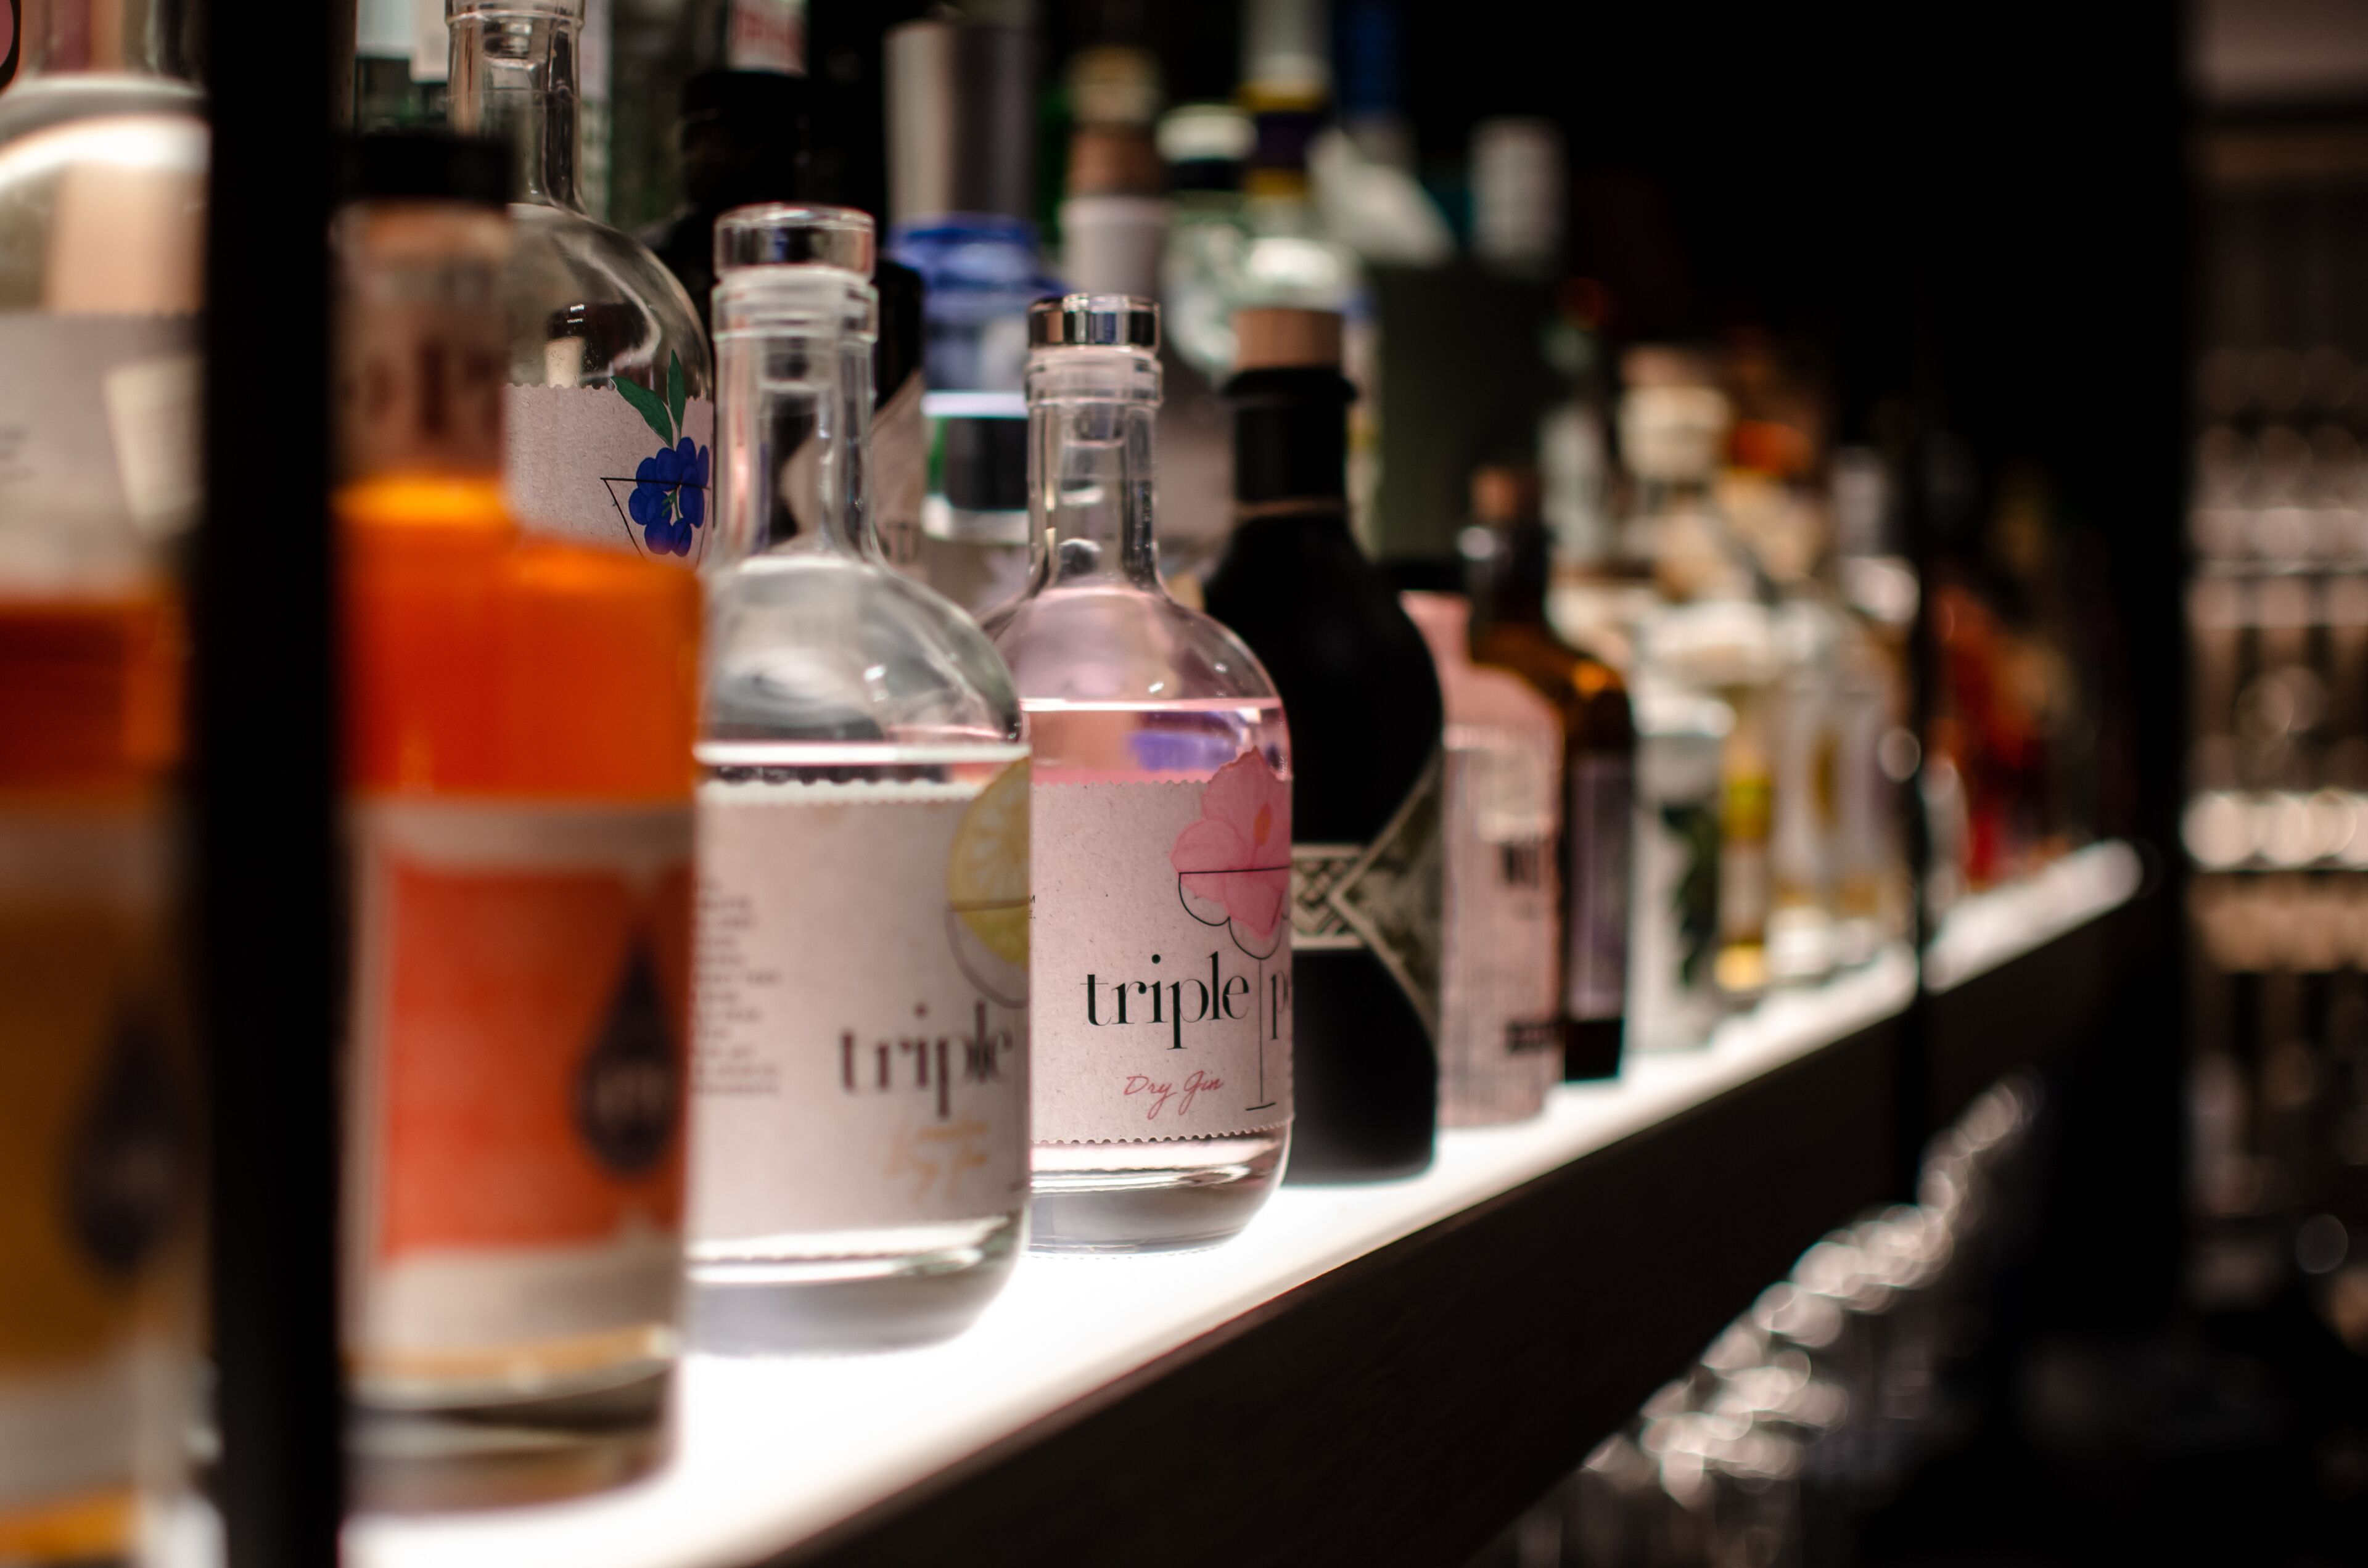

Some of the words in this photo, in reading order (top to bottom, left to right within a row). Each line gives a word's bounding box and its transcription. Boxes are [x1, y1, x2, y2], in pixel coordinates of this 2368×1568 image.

[1080, 951, 1249, 1050] triple
[1124, 1075, 1177, 1120] Dry
[1178, 1070, 1224, 1115] Gin
